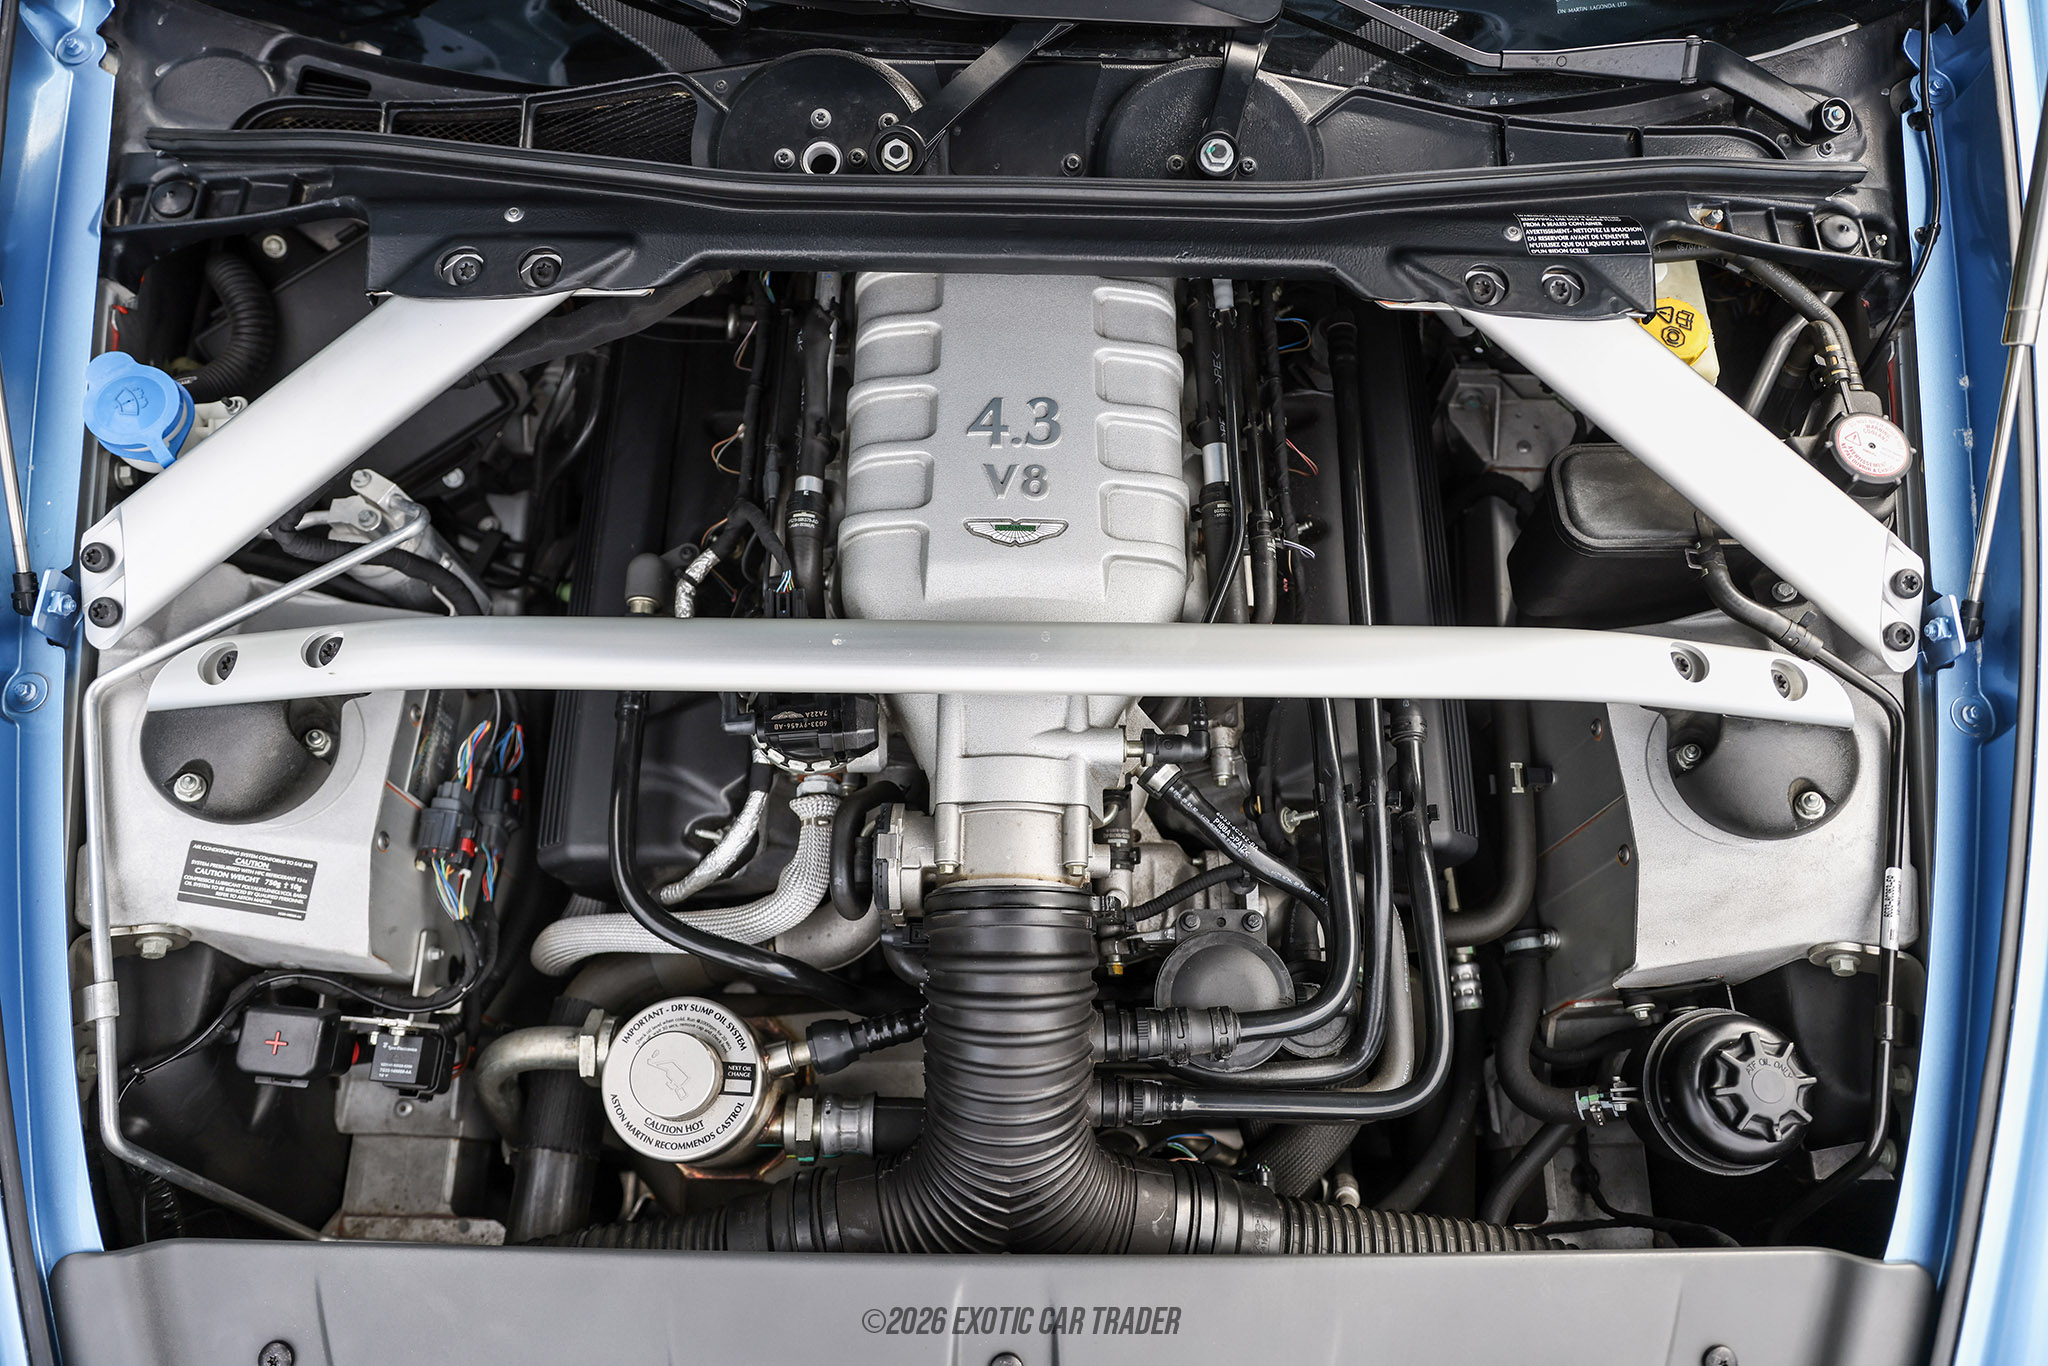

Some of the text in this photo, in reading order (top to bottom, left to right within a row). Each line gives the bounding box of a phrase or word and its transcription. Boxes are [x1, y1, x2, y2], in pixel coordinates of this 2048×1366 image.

[966, 396, 1062, 449] 4.3
[982, 464, 1050, 501] V8
[1213, 817, 1231, 837] P108A
[202, 846, 240, 856] CONDITIONING
[235, 857, 269, 869] CAUTION
[194, 867, 230, 878] CAUTION
[231, 873, 260, 884] WEIGHT
[264, 879, 282, 888] 750g
[266, 872, 296, 882] REFRIGERANT
[254, 892, 278, 900] QUALIFIED
[622, 1008, 664, 1044] IMPORTANT
[671, 1004, 688, 1012] DRY
[690, 1004, 714, 1015] SUMP
[714, 1013, 727, 1026] OIL
[726, 1022, 748, 1051] SYSTEM
[711, 1033, 722, 1044] check
[1745, 1058, 1793, 1078] ATF OIL ONLY
[610, 1094, 745, 1151] ASTON MARTIN RECOMMENDS CASTROL
[644, 1117, 705, 1134] CAUTION HOT
